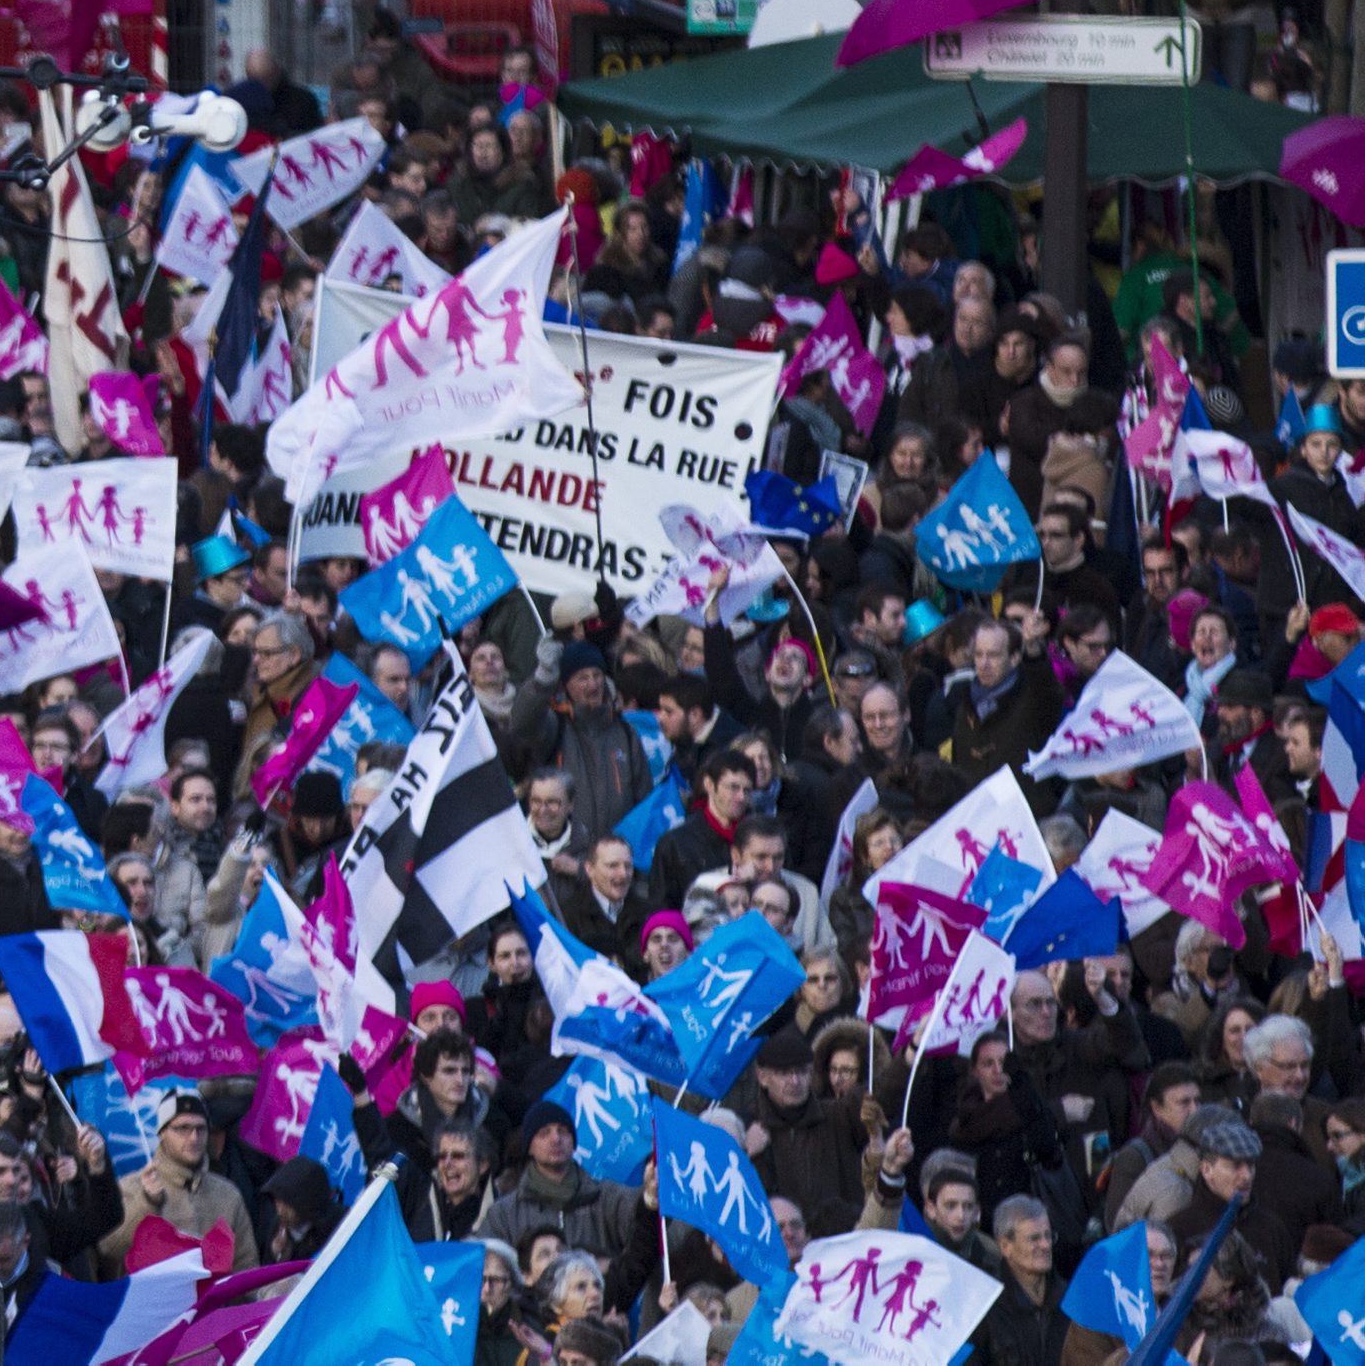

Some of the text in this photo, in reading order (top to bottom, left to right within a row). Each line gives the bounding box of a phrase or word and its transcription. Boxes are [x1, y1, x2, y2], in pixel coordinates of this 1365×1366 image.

[624, 378, 719, 430] FOIS
[535, 418, 619, 462] DANS
[627, 437, 667, 472] LA
[675, 448, 739, 491] RUE
